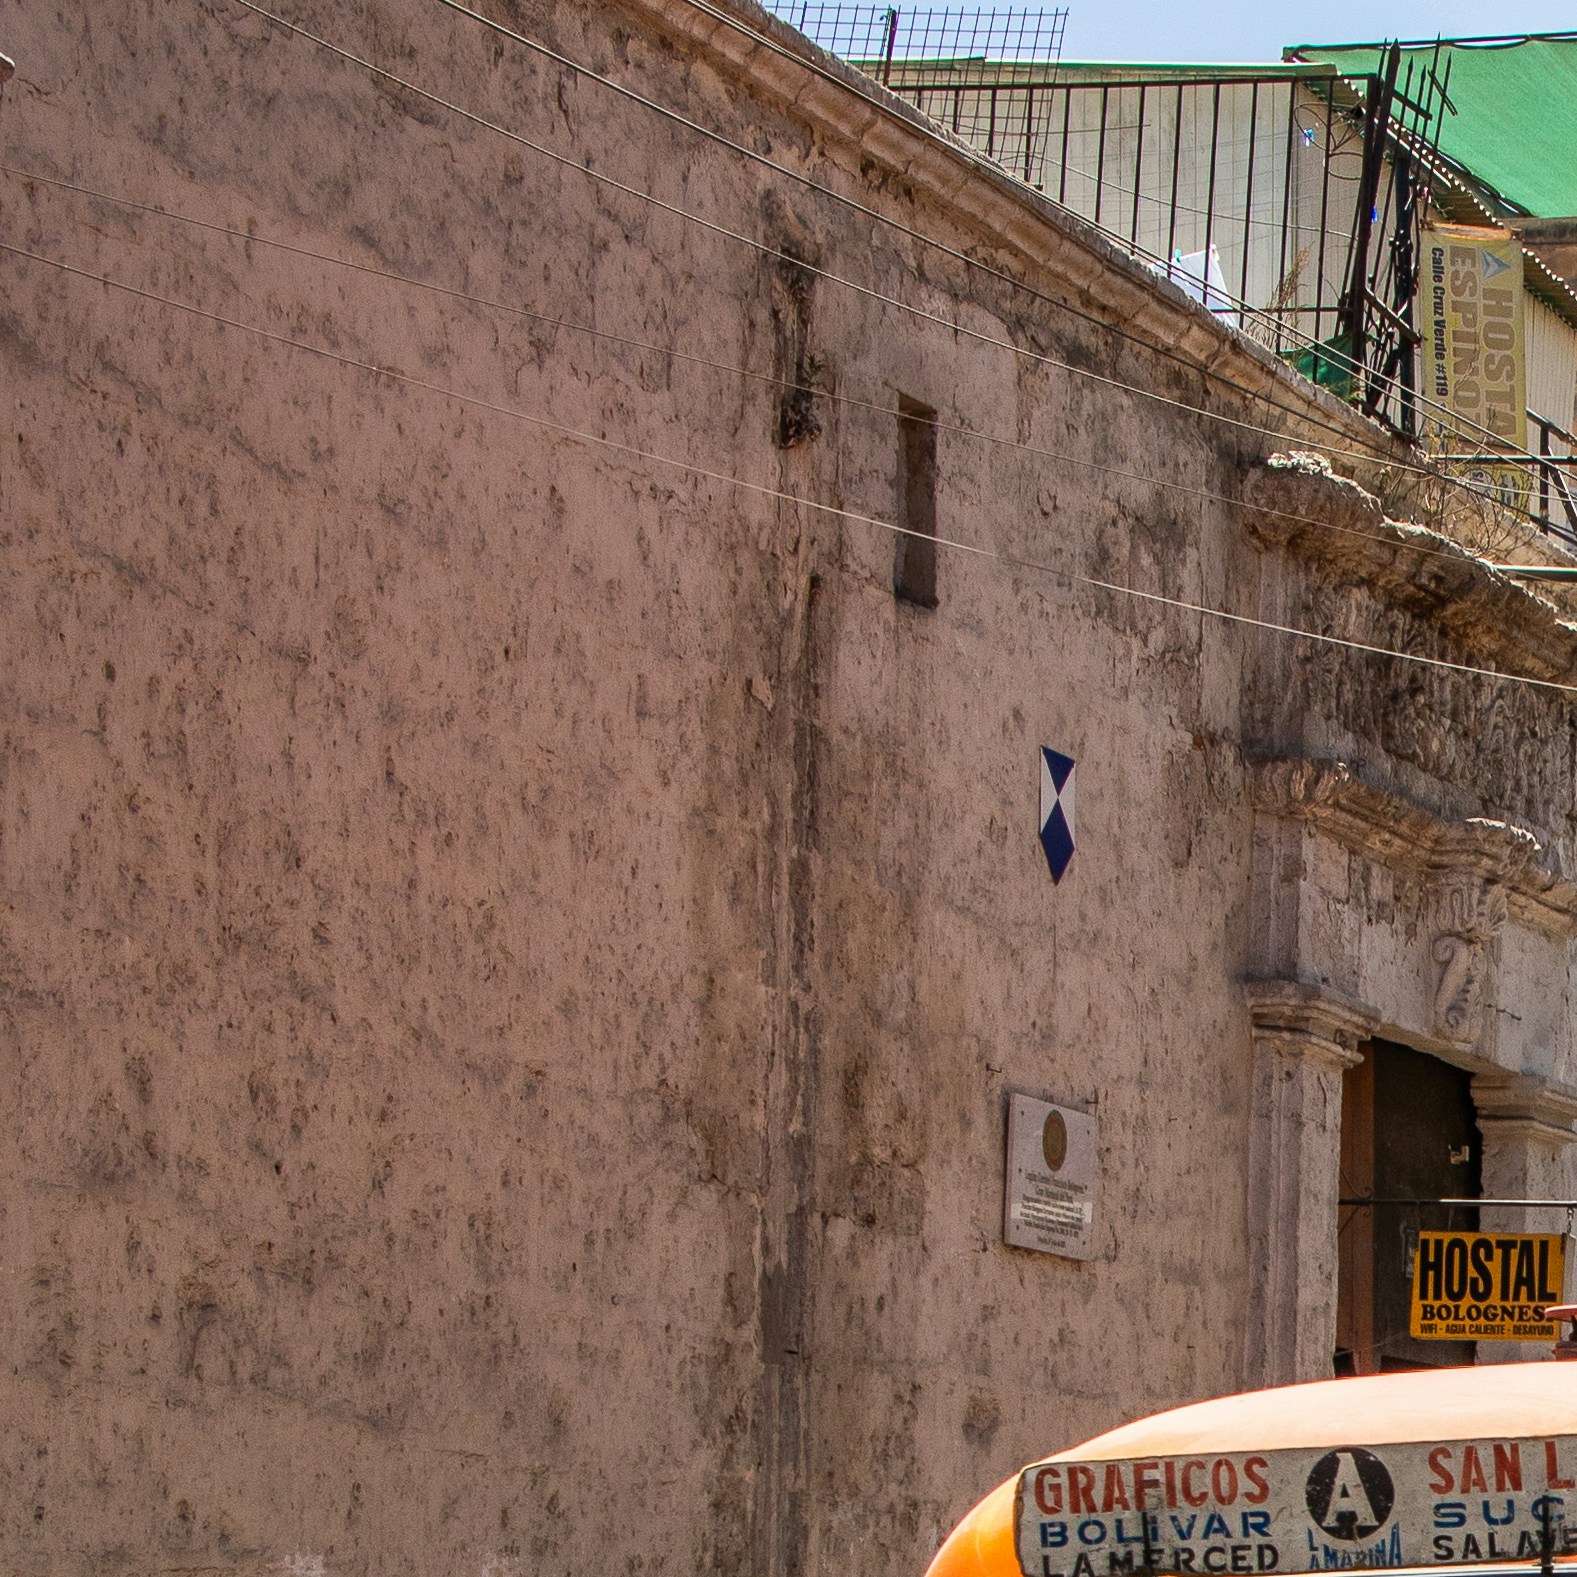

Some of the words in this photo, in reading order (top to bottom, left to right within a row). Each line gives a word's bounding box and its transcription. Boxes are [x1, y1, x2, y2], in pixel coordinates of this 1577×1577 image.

[1431, 247, 1445, 283] Calle
[1433, 286, 1446, 317] Cruz
[1433, 319, 1447, 359] Verde
[1449, 246, 1481, 436] ESPINOZ
[1435, 363, 1449, 397] #119
[1482, 287, 1517, 436] HOSTA
[1419, 1238, 1557, 1302] HOSTAL
[1421, 1304, 1556, 1322] BOLOGNES
[1445, 1324, 1466, 1334] AGUA
[1469, 1324, 1505, 1335] CALIENTE
[1513, 1325, 1554, 1336] DESAYUNO
[1034, 1456, 1270, 1515] GRAFICOS
[1428, 1443, 1523, 1495] SAN
[1324, 1452, 1380, 1528] A
[1039, 1510, 1271, 1548] BOLIVAR
[1108, 1543, 1279, 1575] MERCED
